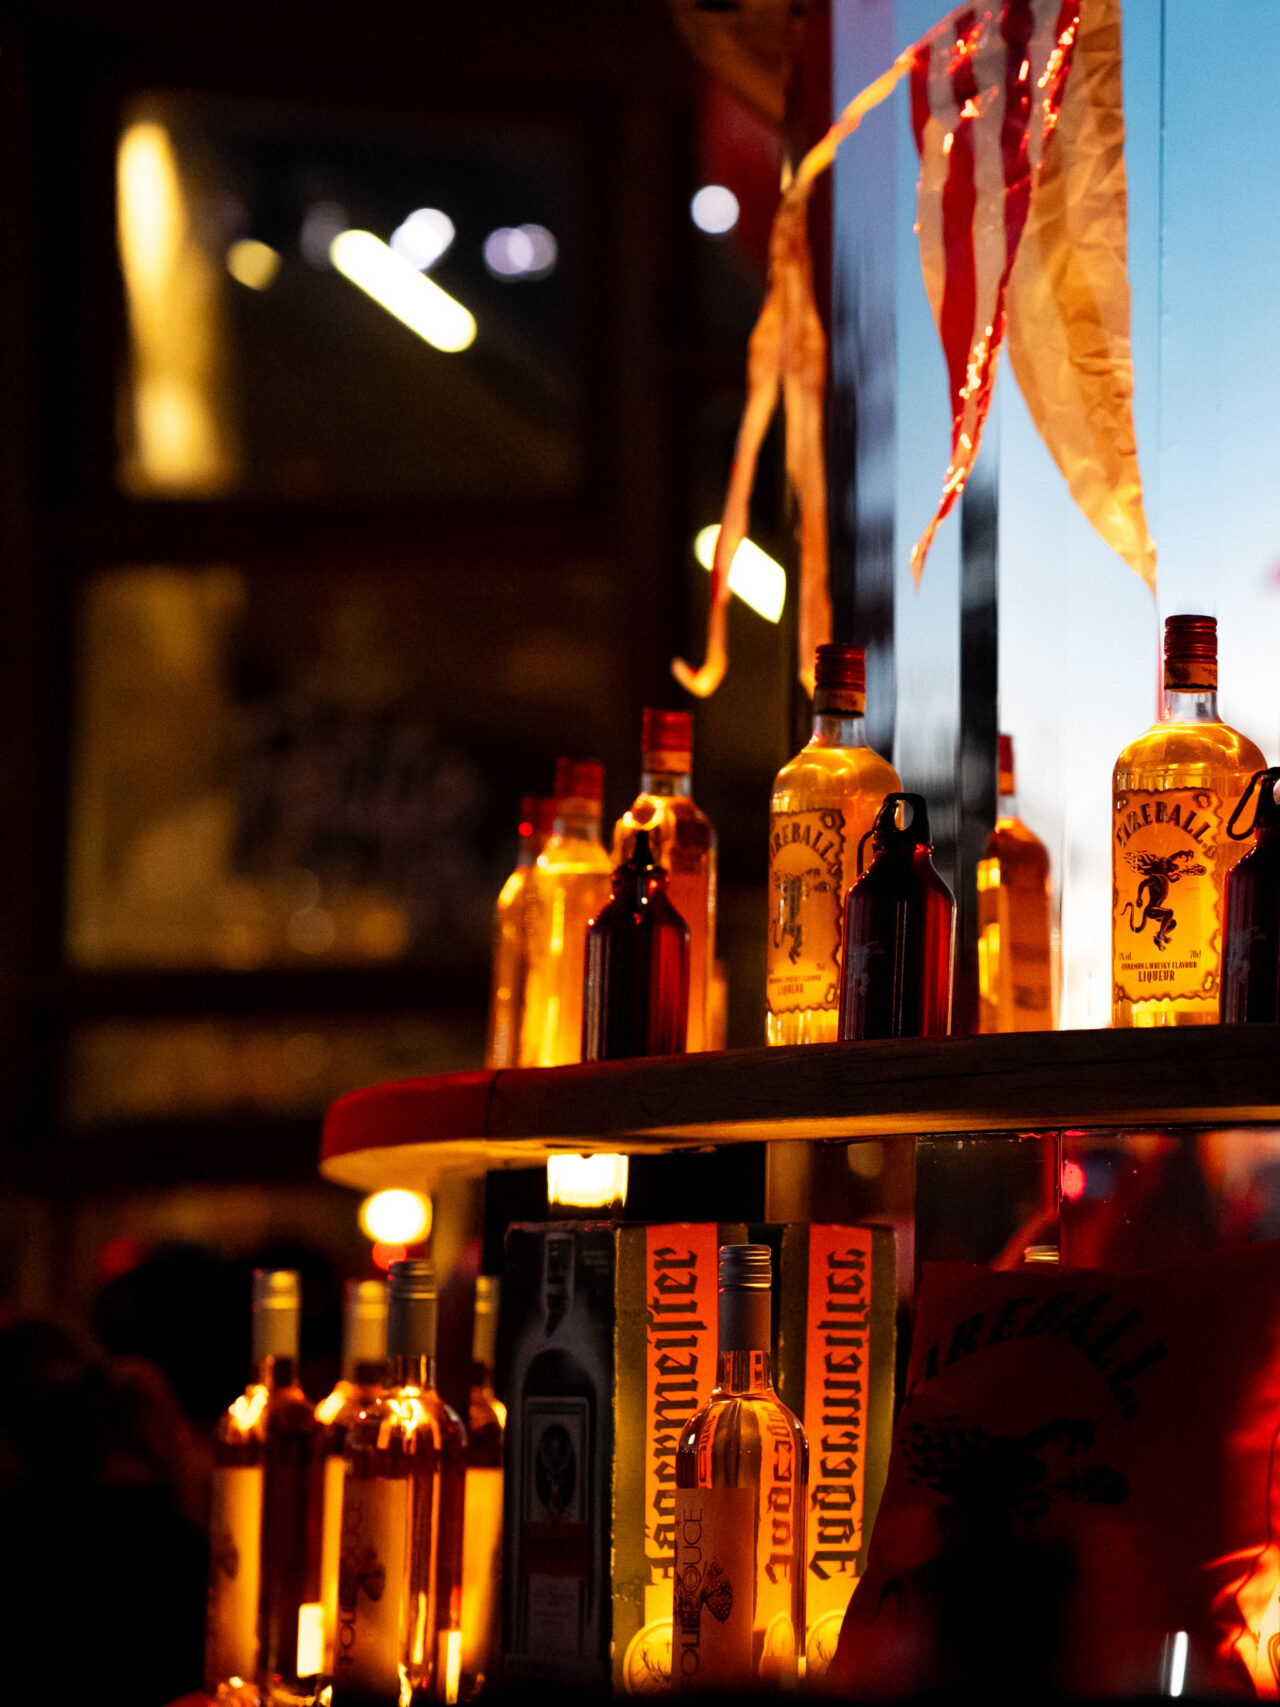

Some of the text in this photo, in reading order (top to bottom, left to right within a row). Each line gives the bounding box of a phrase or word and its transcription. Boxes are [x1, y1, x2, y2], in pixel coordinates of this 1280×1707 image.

[770, 823, 834, 864] IREBALL
[1116, 801, 1212, 848] FIREBALL
[1138, 970, 1175, 983] LIQUEUR
[926, 1293, 1168, 1405] IREBALL
